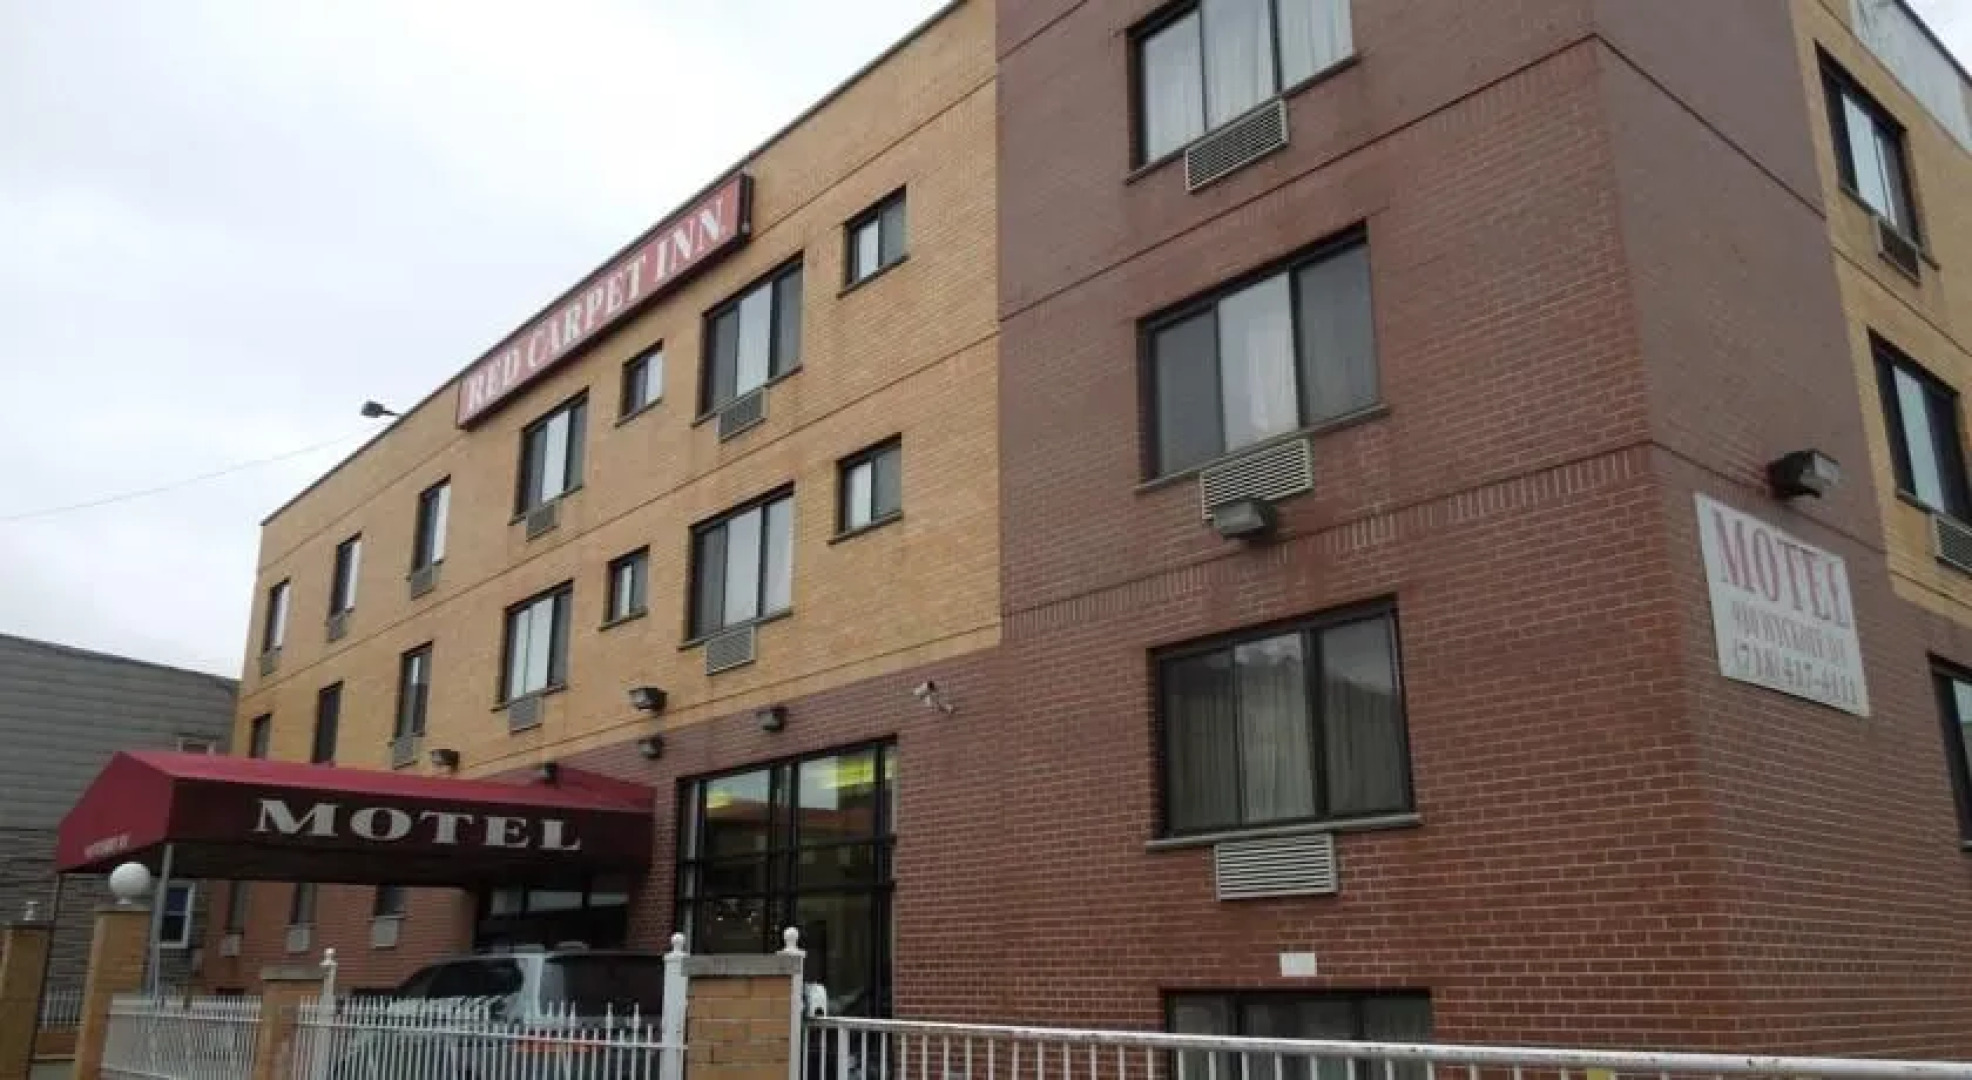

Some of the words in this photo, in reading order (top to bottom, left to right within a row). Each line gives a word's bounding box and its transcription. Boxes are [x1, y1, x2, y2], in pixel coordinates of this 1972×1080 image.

[466, 348, 520, 412] RED
[526, 253, 647, 370] CARPET
[654, 196, 725, 284] INN
[1712, 509, 1850, 628] MOTEL
[253, 797, 582, 852] MOTEL
